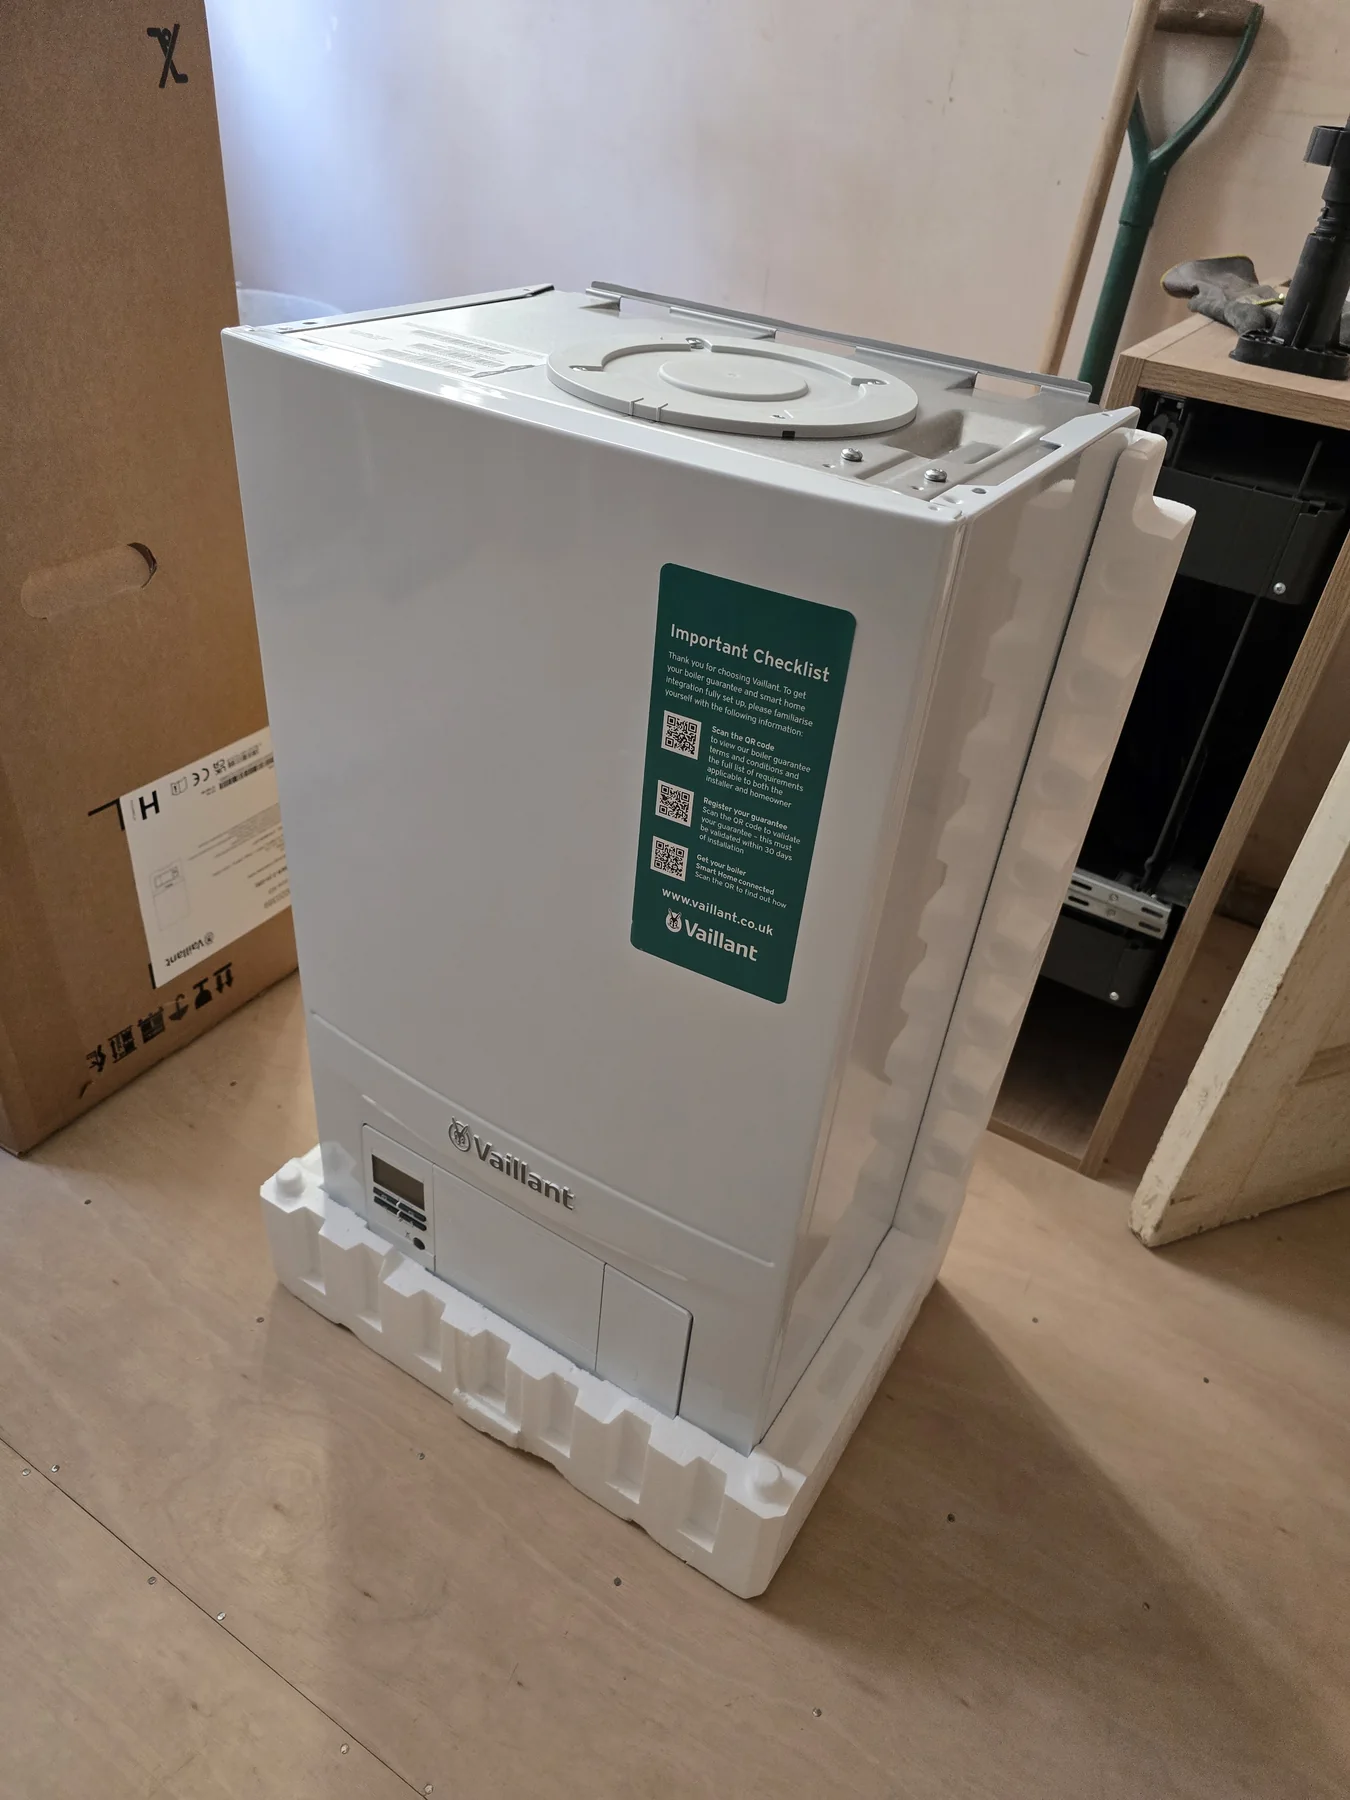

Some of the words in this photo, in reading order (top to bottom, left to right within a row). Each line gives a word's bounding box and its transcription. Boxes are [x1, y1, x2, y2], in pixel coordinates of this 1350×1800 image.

[670, 623, 749, 660] Important
[753, 648, 830, 683] Checklist
[666, 664, 684, 675] your
[684, 668, 705, 682] boiler
[705, 677, 743, 694] guarantee
[743, 688, 759, 699] and
[759, 693, 783, 706] smart
[783, 698, 806, 712] home
[668, 650, 690, 665] Thank
[691, 659, 705, 669] you
[705, 662, 717, 673] for
[717, 667, 751, 685] choosing
[752, 676, 781, 693] Vaillant.
[783, 685, 792, 695] To
[792, 690, 807, 700] get
[664, 688, 693, 703] yourself
[694, 698, 710, 708] with
[710, 701, 724, 713] the
[724, 706, 757, 725] following
[757, 717, 804, 737] information:
[665, 675, 704, 694] integration
[705, 687, 722, 701] fully
[722, 694, 734, 704] set
[735, 699, 747, 709] up,
[747, 702, 773, 715] please
[773, 708, 814, 727] familiarise
[710, 735, 719, 745] to
[719, 739, 736, 750] view
[736, 745, 750, 754] our
[750, 748, 773, 761] boiler
[772, 756, 811, 773] guarantee
[711, 725, 730, 738] Scan
[730, 731, 744, 742] the
[744, 736, 757, 746] QR
[756, 741, 775, 752] code
[706, 766, 743, 783] applicable
[743, 776, 752, 786] to
[752, 779, 770, 792] both
[770, 785, 784, 796] the
[708, 755, 720, 766] the
[721, 759, 734, 770] full
[733, 763, 745, 774] list
[746, 768, 755, 776] of
[755, 772, 804, 792] requirements
[709, 745, 730, 759] terms
[730, 754, 746, 763] and
[745, 758, 784, 776] conditions
[784, 770, 800, 780] and
[139, 790, 160, 820] H
[705, 775, 734, 790] installer
[734, 785, 749, 795] and
[749, 788, 792, 808] homeowner
[702, 805, 719, 818] Scan
[719, 812, 732, 822] the
[732, 816, 744, 826] QR
[744, 821, 763, 832] code
[763, 826, 772, 835] to
[772, 830, 801, 845] validate
[703, 796, 733, 813] Register
[733, 808, 751, 818] your
[750, 814, 788, 831] guarantee
[700, 823, 709, 833] be
[709, 828, 741, 844] validated
[742, 840, 763, 852] within
[764, 846, 775, 855] 30
[775, 850, 793, 861] days
[701, 816, 717, 826] your
[717, 822, 753, 839] guarantee
[759, 834, 773, 845] this
[773, 841, 793, 852] must
[707, 836, 745, 855] installation
[695, 862, 717, 876] Smart
[717, 870, 738, 883] Home
[737, 878, 775, 896] connected
[696, 853, 709, 864] Get
[709, 859, 726, 869] your
[726, 864, 747, 877] boiler
[694, 870, 711, 882] Scan
[711, 876, 724, 887] the
[724, 881, 735, 891] QR
[735, 885, 744, 894] to
[744, 888, 759, 899] find
[758, 895, 771, 904] out
[771, 898, 787, 909] how
[661, 888, 774, 936] www.vaillant.co.uk
[165, 939, 205, 967] Vaillant
[684, 918, 758, 962] Vaillant
[473, 1134, 576, 1211] Vaillant
